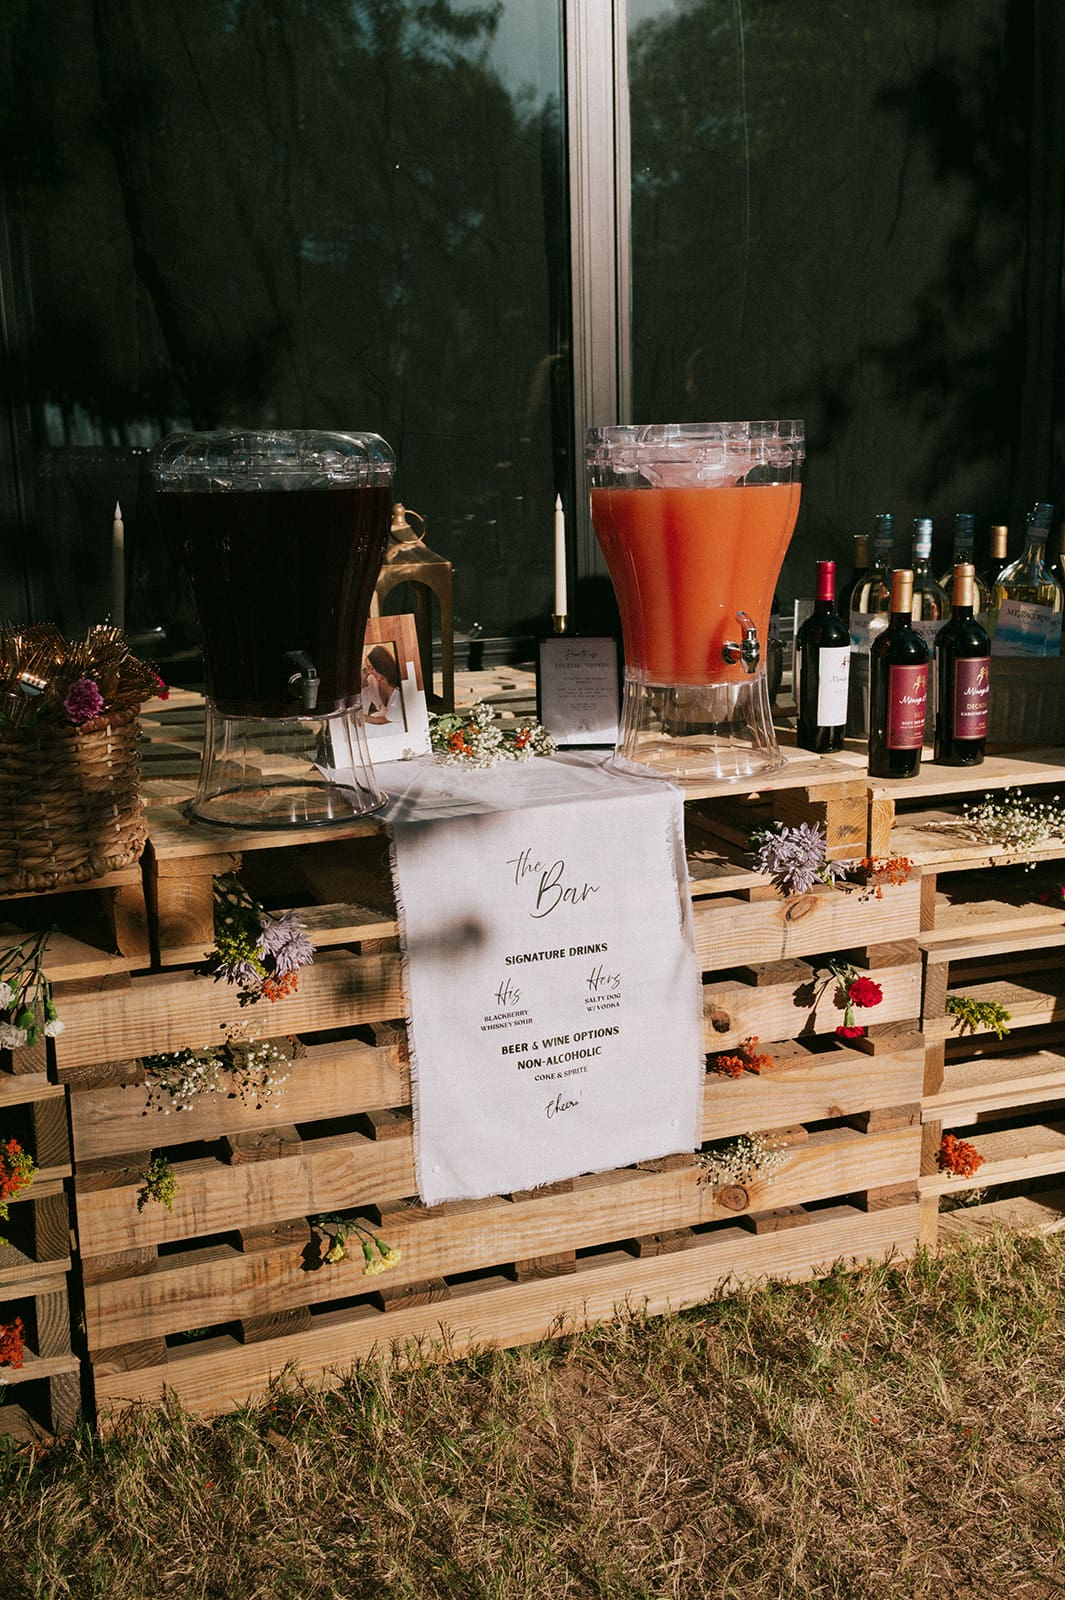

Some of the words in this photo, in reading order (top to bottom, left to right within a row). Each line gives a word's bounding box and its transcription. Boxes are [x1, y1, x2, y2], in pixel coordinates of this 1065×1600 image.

[530, 860, 600, 918] Bar
[505, 948, 565, 966] SIGNATURE
[569, 942, 608, 957] DRINKS
[586, 964, 621, 991] Hers
[494, 977, 520, 1006] His
[585, 995, 605, 1004] SALTY
[606, 992, 621, 1000] DOG
[484, 1009, 528, 1022] BLACKBERRY
[597, 1001, 620, 1010] VODKA
[480, 1021, 512, 1031] WHISKEY
[514, 1017, 533, 1027] SOUR
[501, 1042, 528, 1055] BEER
[532, 1041, 538, 1050] &
[542, 1035, 570, 1048] WINE
[573, 1026, 620, 1042] OPTIONS
[517, 1046, 602, 1070] NON-ALCOHOLIC
[534, 1073, 556, 1082] COKE
[556, 1071, 562, 1079] &
[563, 1066, 588, 1077] SPRITE
